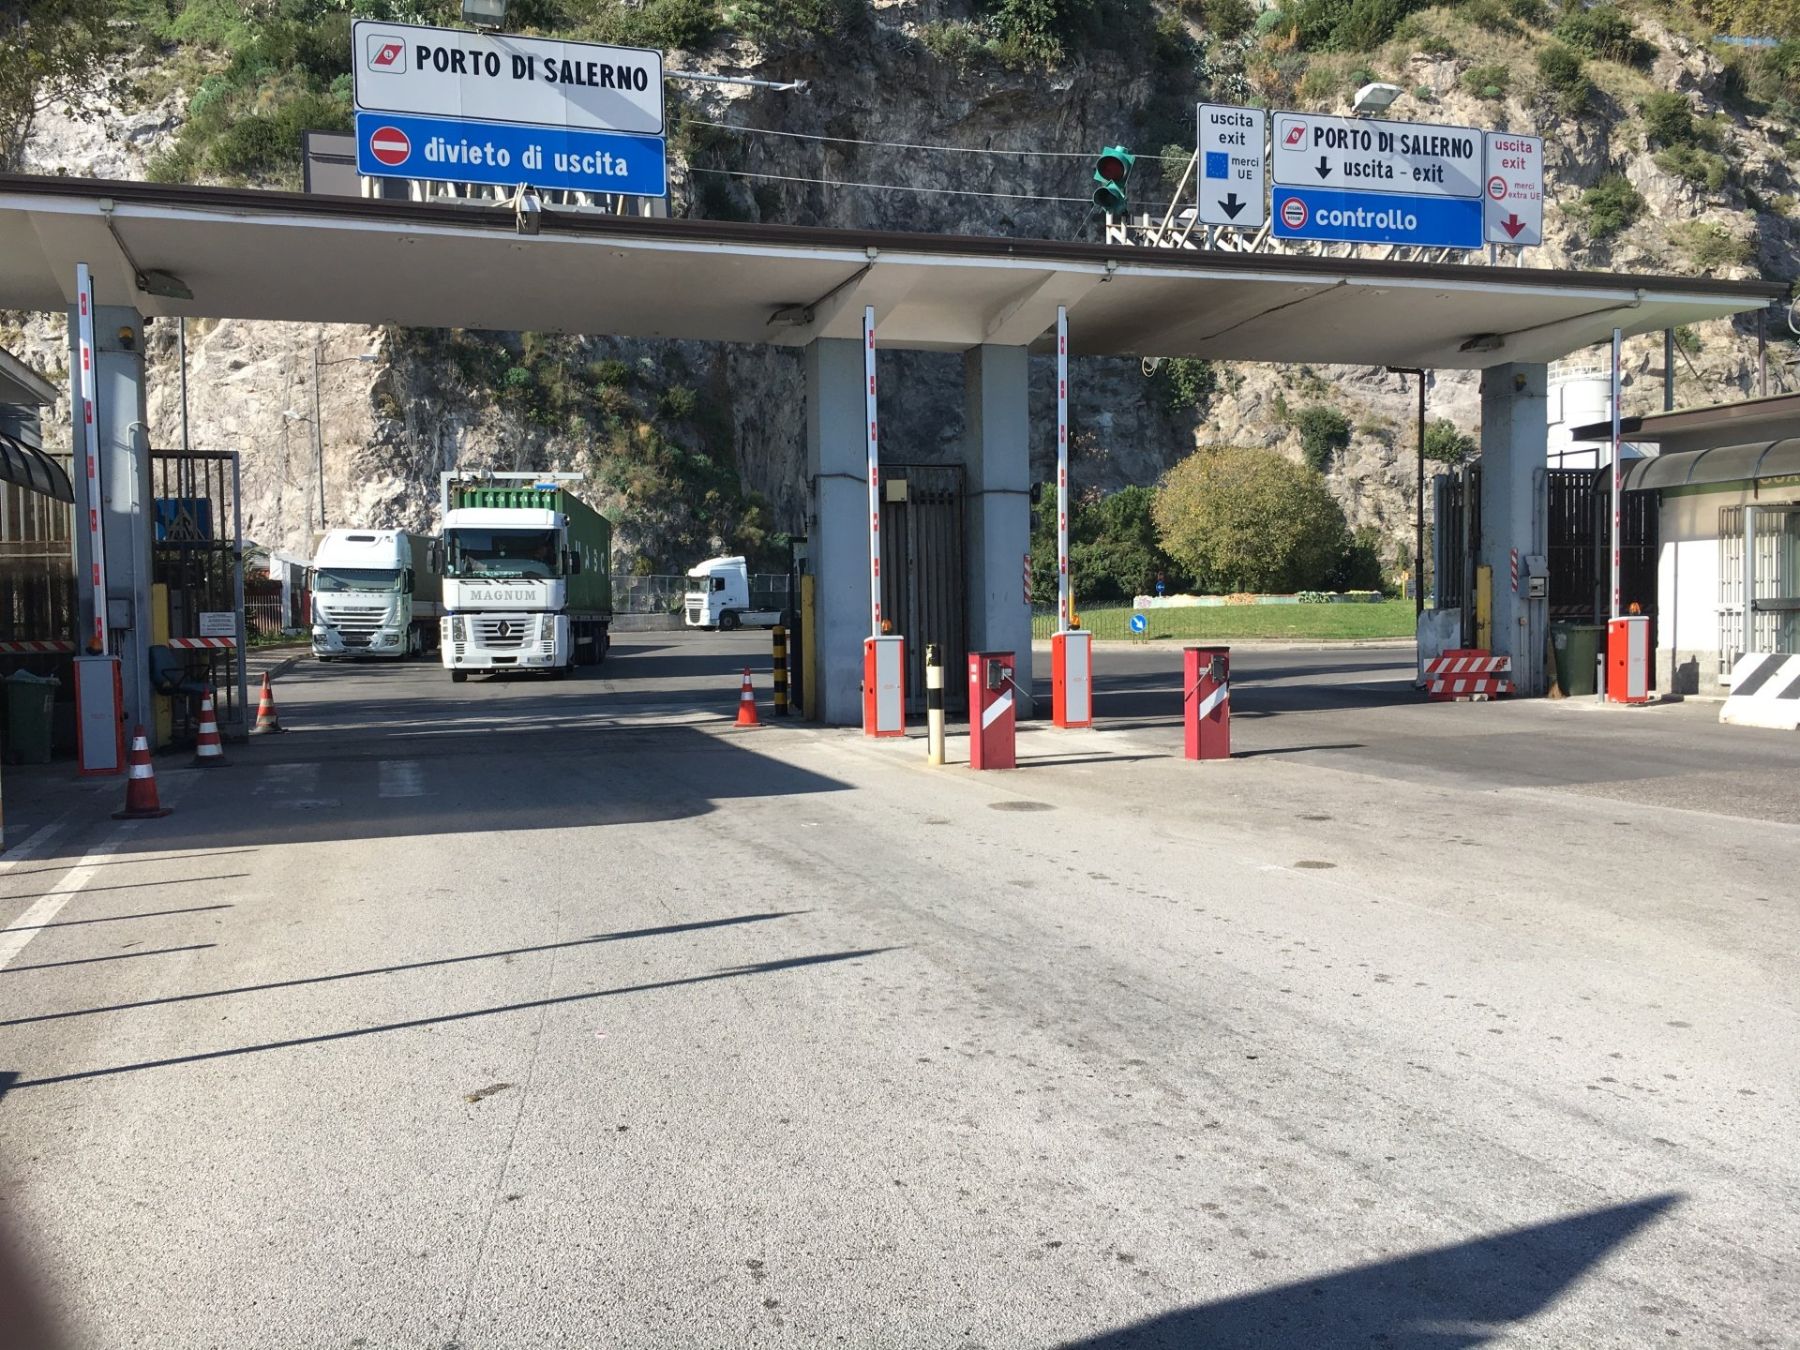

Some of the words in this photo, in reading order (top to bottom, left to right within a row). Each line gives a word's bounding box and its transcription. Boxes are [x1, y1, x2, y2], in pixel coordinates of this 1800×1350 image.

[416, 45, 501, 77] PORTO
[511, 54, 535, 80] DI
[543, 57, 648, 91] SALERNO
[1211, 112, 1253, 127] uscita
[1219, 131, 1246, 146] exit
[1314, 126, 1372, 151] PORTO
[1378, 131, 1394, 152] DI
[1400, 134, 1473, 159] SALERNO
[1495, 139, 1533, 153] uscita
[424, 136, 511, 167] divieto
[521, 144, 543, 169] di
[554, 150, 629, 177] uscita
[1231, 157, 1259, 167] merci
[1502, 157, 1526, 170] exit
[1237, 169, 1253, 180] UE
[1343, 159, 1394, 179] uscita
[1412, 163, 1444, 183] exit
[1514, 182, 1535, 190] merci
[1508, 191, 1527, 200] extra
[1530, 192, 1541, 201] UE
[1315, 207, 1418, 231] controllo
[470, 589, 537, 601] MAGNUM
